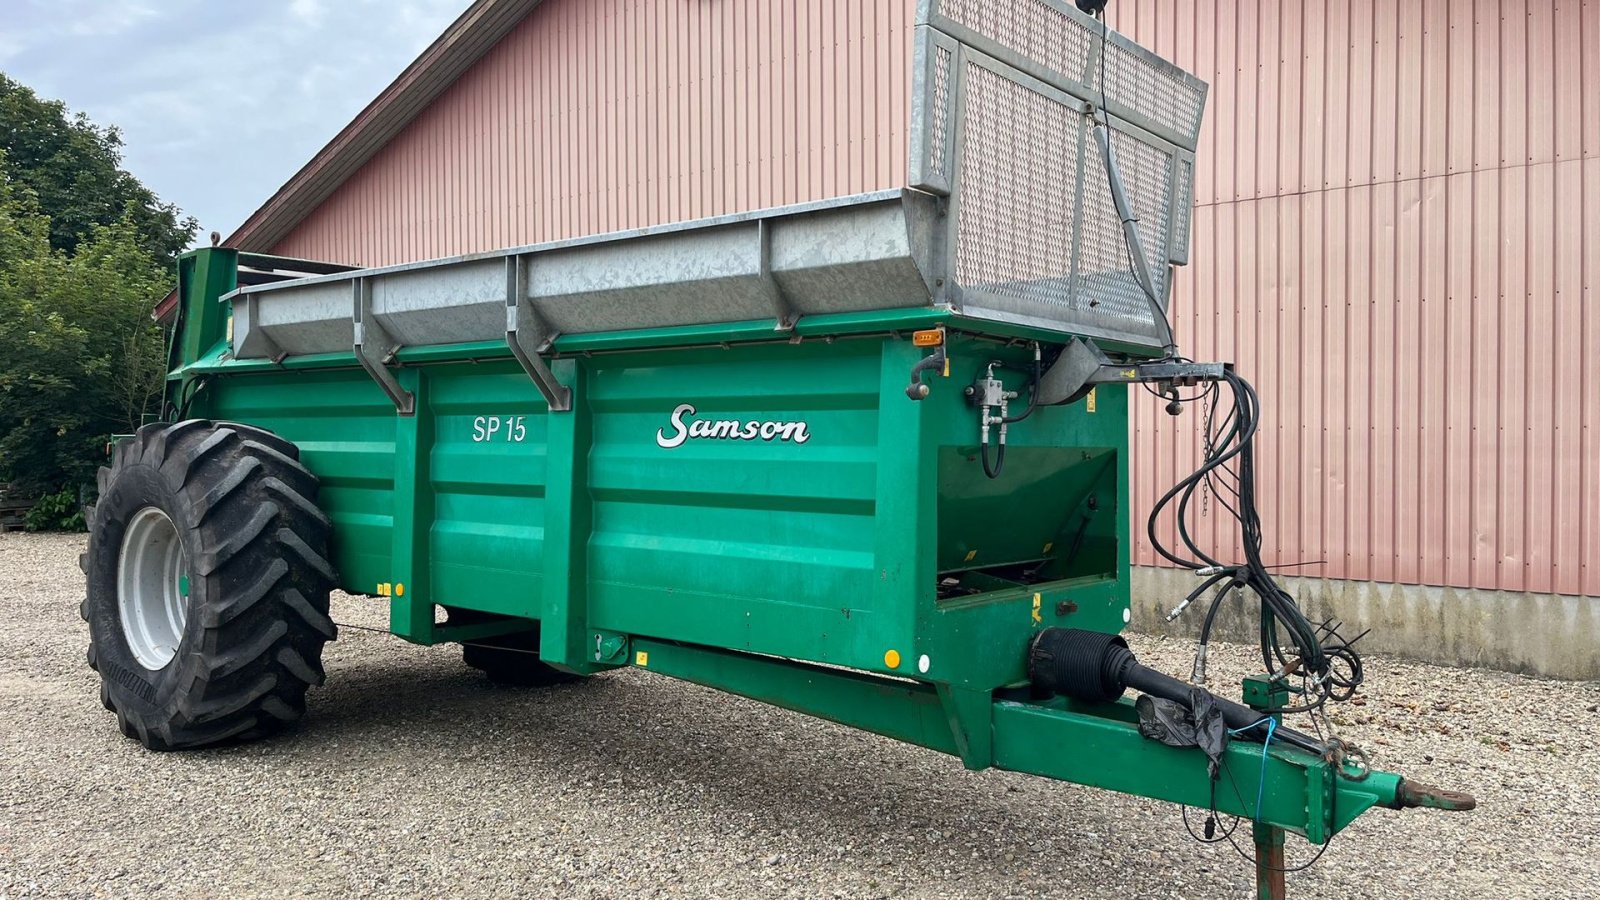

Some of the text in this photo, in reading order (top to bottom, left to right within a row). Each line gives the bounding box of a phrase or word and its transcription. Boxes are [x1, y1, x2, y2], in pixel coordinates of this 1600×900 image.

[472, 416, 526, 442] SP 15
[656, 403, 810, 448] Samson
